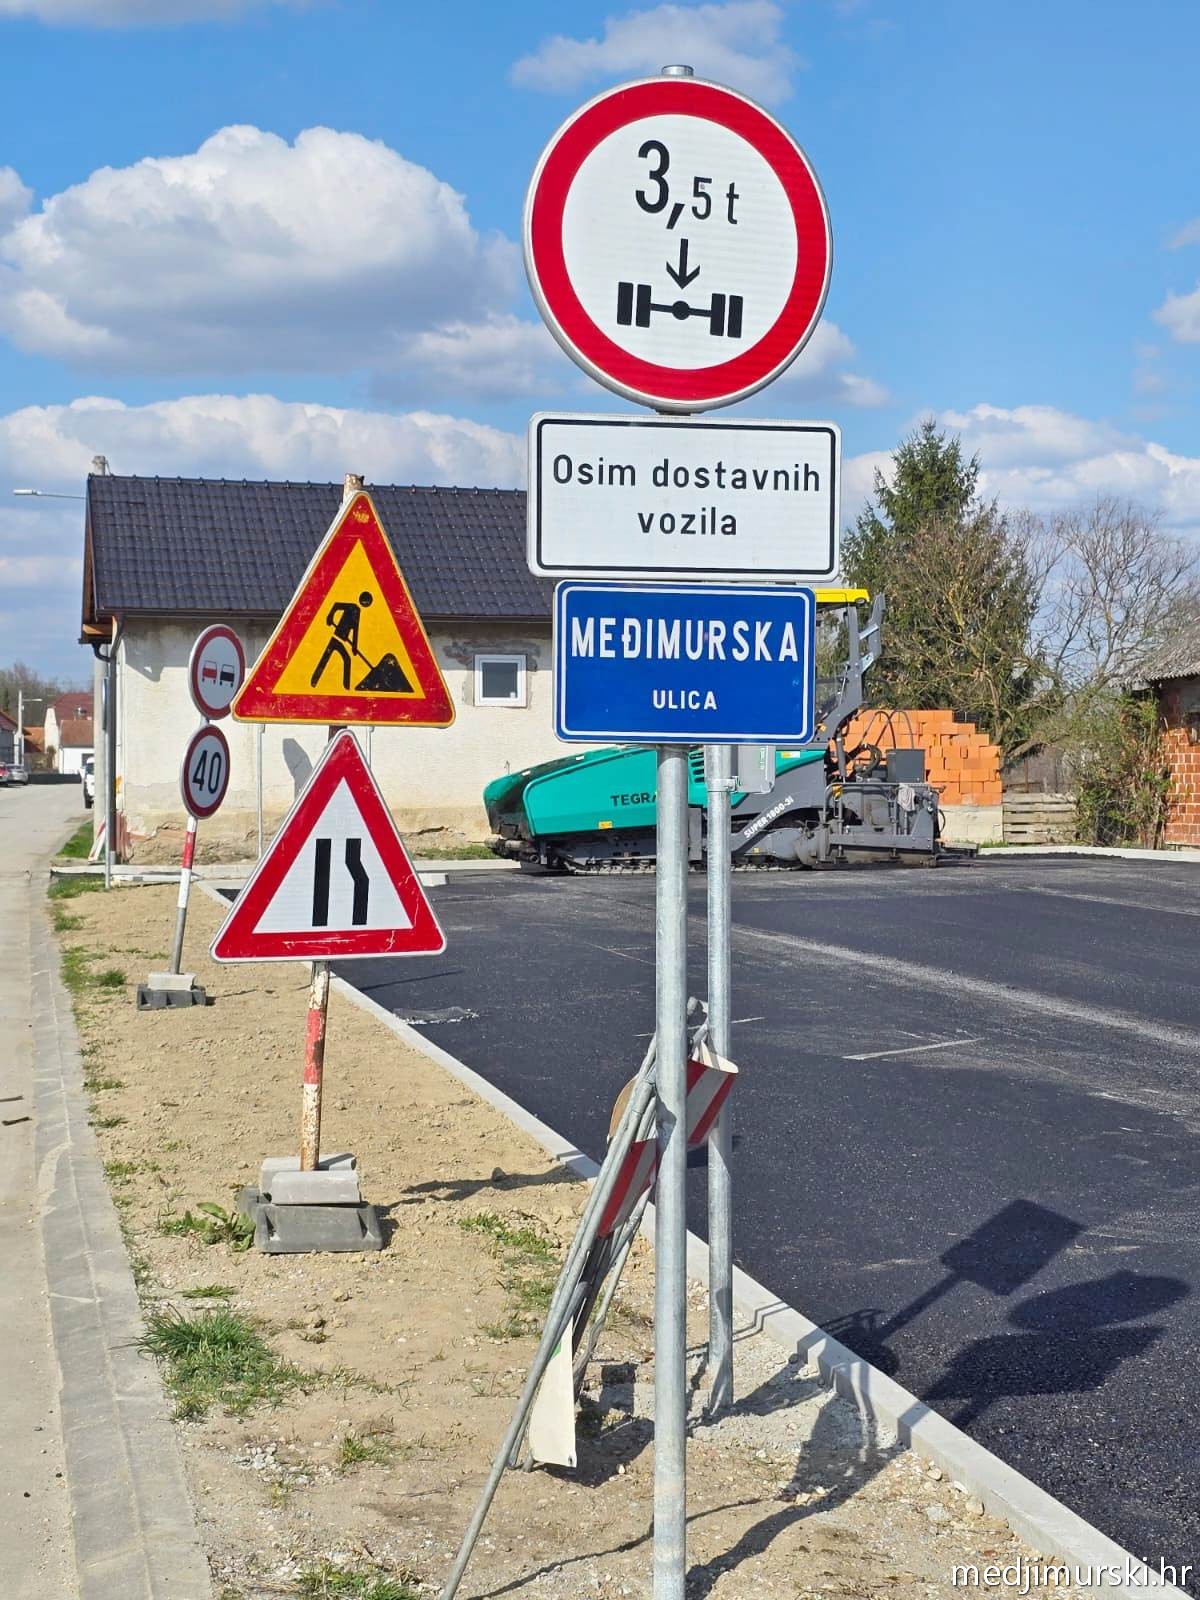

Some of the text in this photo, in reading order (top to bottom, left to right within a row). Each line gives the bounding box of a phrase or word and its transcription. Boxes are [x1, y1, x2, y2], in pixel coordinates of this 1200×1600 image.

[635, 140, 740, 230] 3,5 t
[553, 454, 821, 492] Osim dostavnih
[638, 507, 738, 536] vozila
[570, 616, 799, 662] MEĐIMURSKA
[652, 689, 718, 711] ULICA
[192, 749, 222, 795] 40
[743, 816, 769, 839] SUPER
